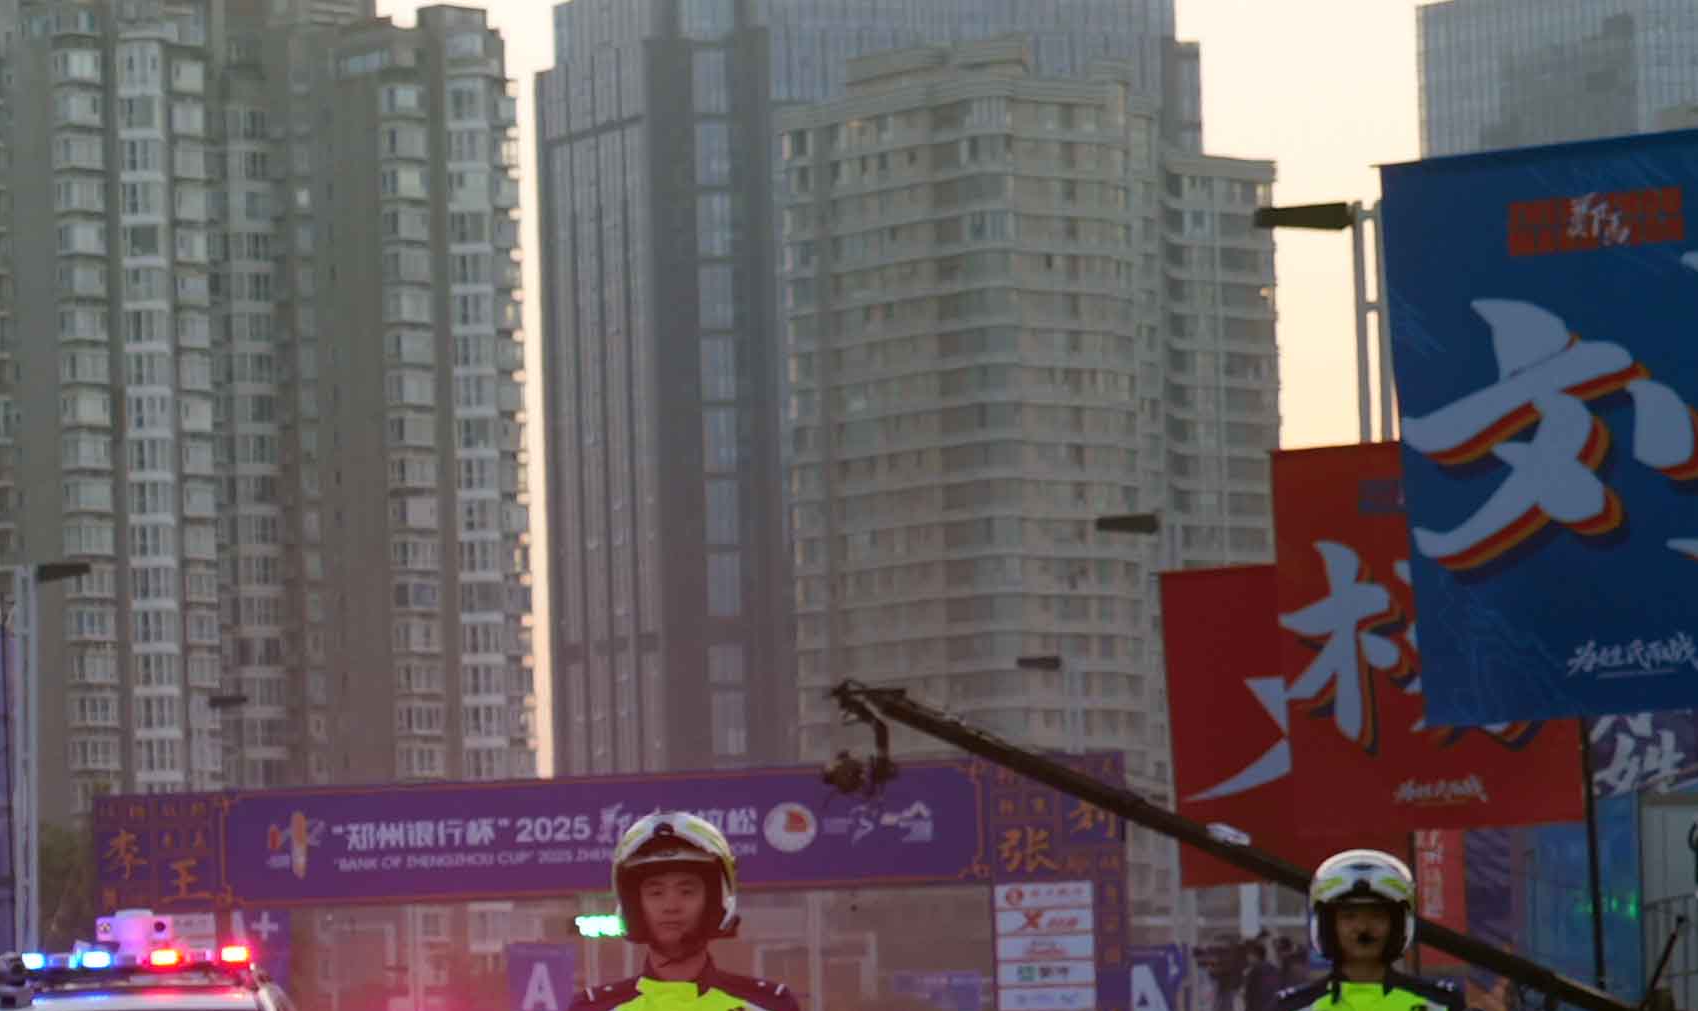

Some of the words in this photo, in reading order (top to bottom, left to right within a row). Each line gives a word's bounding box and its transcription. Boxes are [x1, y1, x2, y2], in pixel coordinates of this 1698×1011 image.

[515, 815, 591, 843] 2025
[999, 825, 1059, 872] 张
[522, 961, 559, 1011] A
